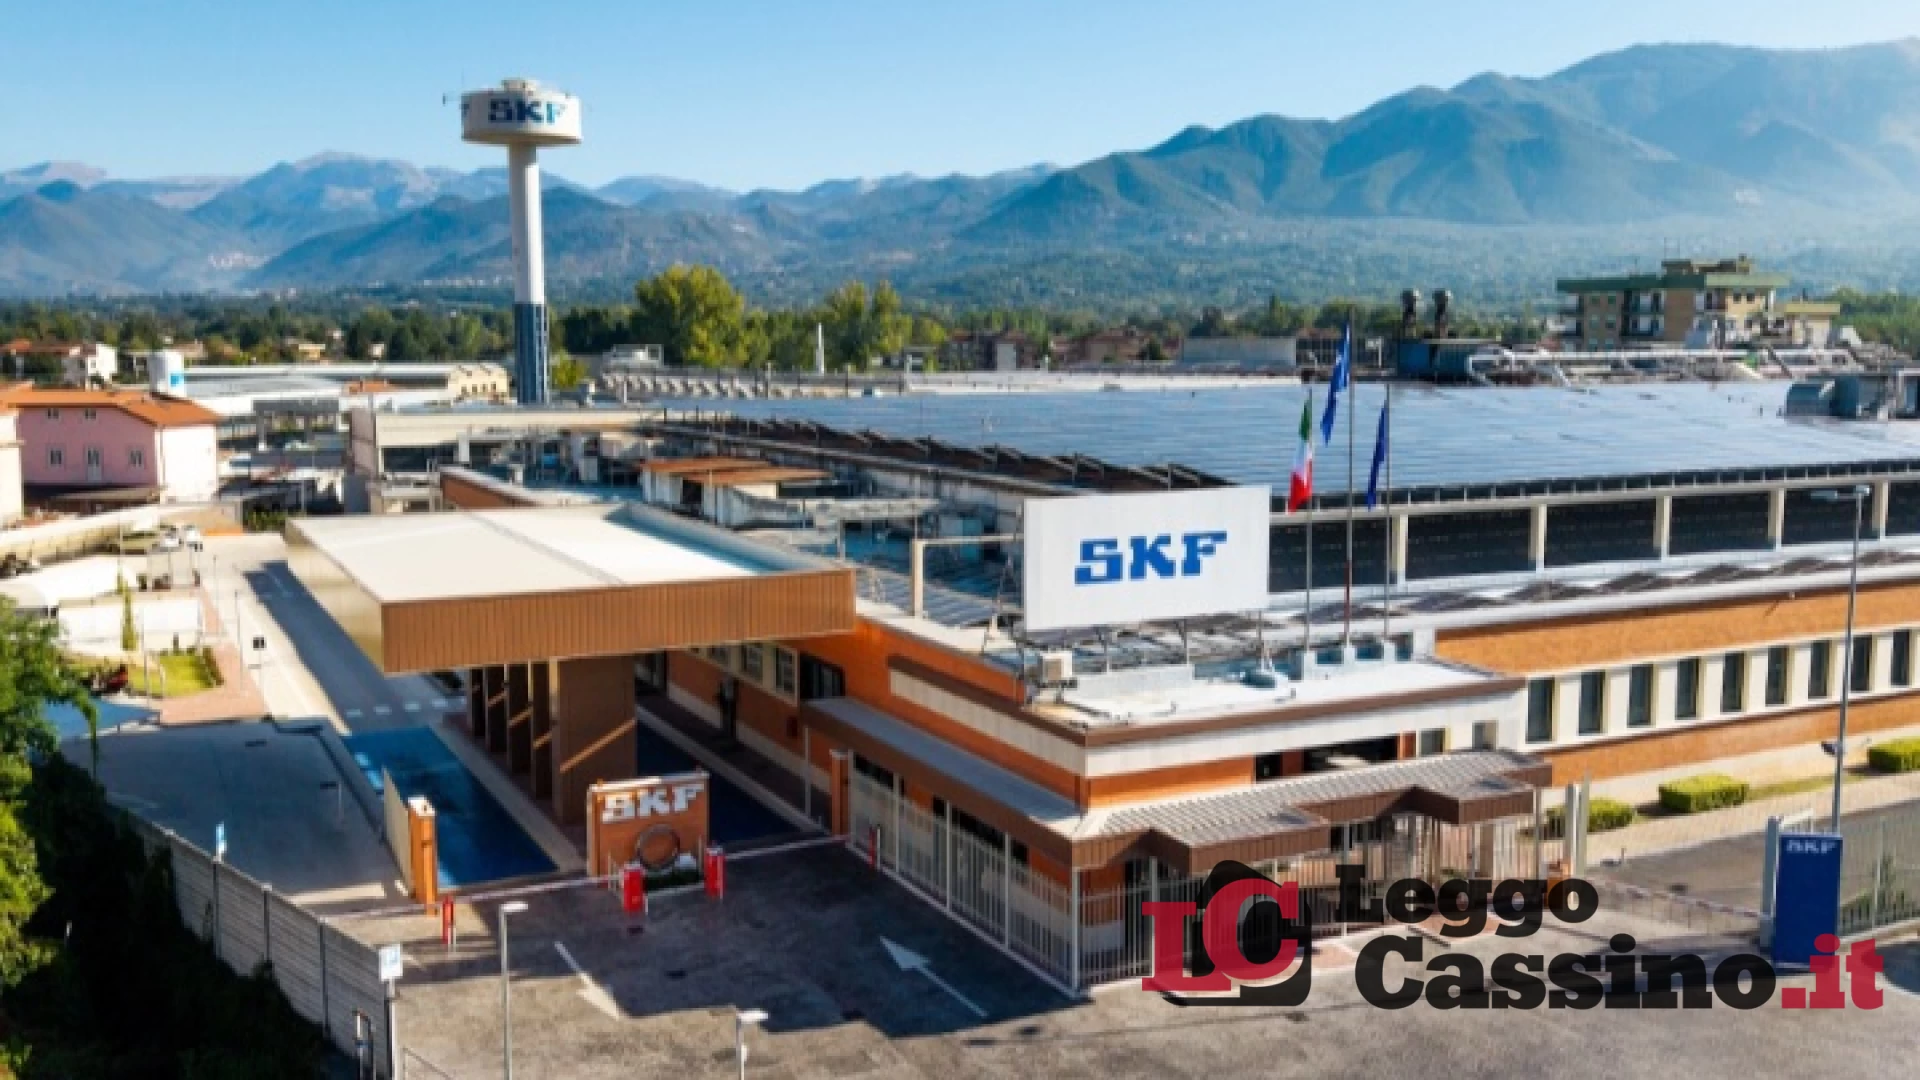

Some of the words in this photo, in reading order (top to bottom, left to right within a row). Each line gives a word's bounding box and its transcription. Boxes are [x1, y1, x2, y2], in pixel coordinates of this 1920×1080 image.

[489, 99, 566, 123] SKF
[1075, 531, 1227, 584] SKF
[602, 785, 704, 822] SKF
